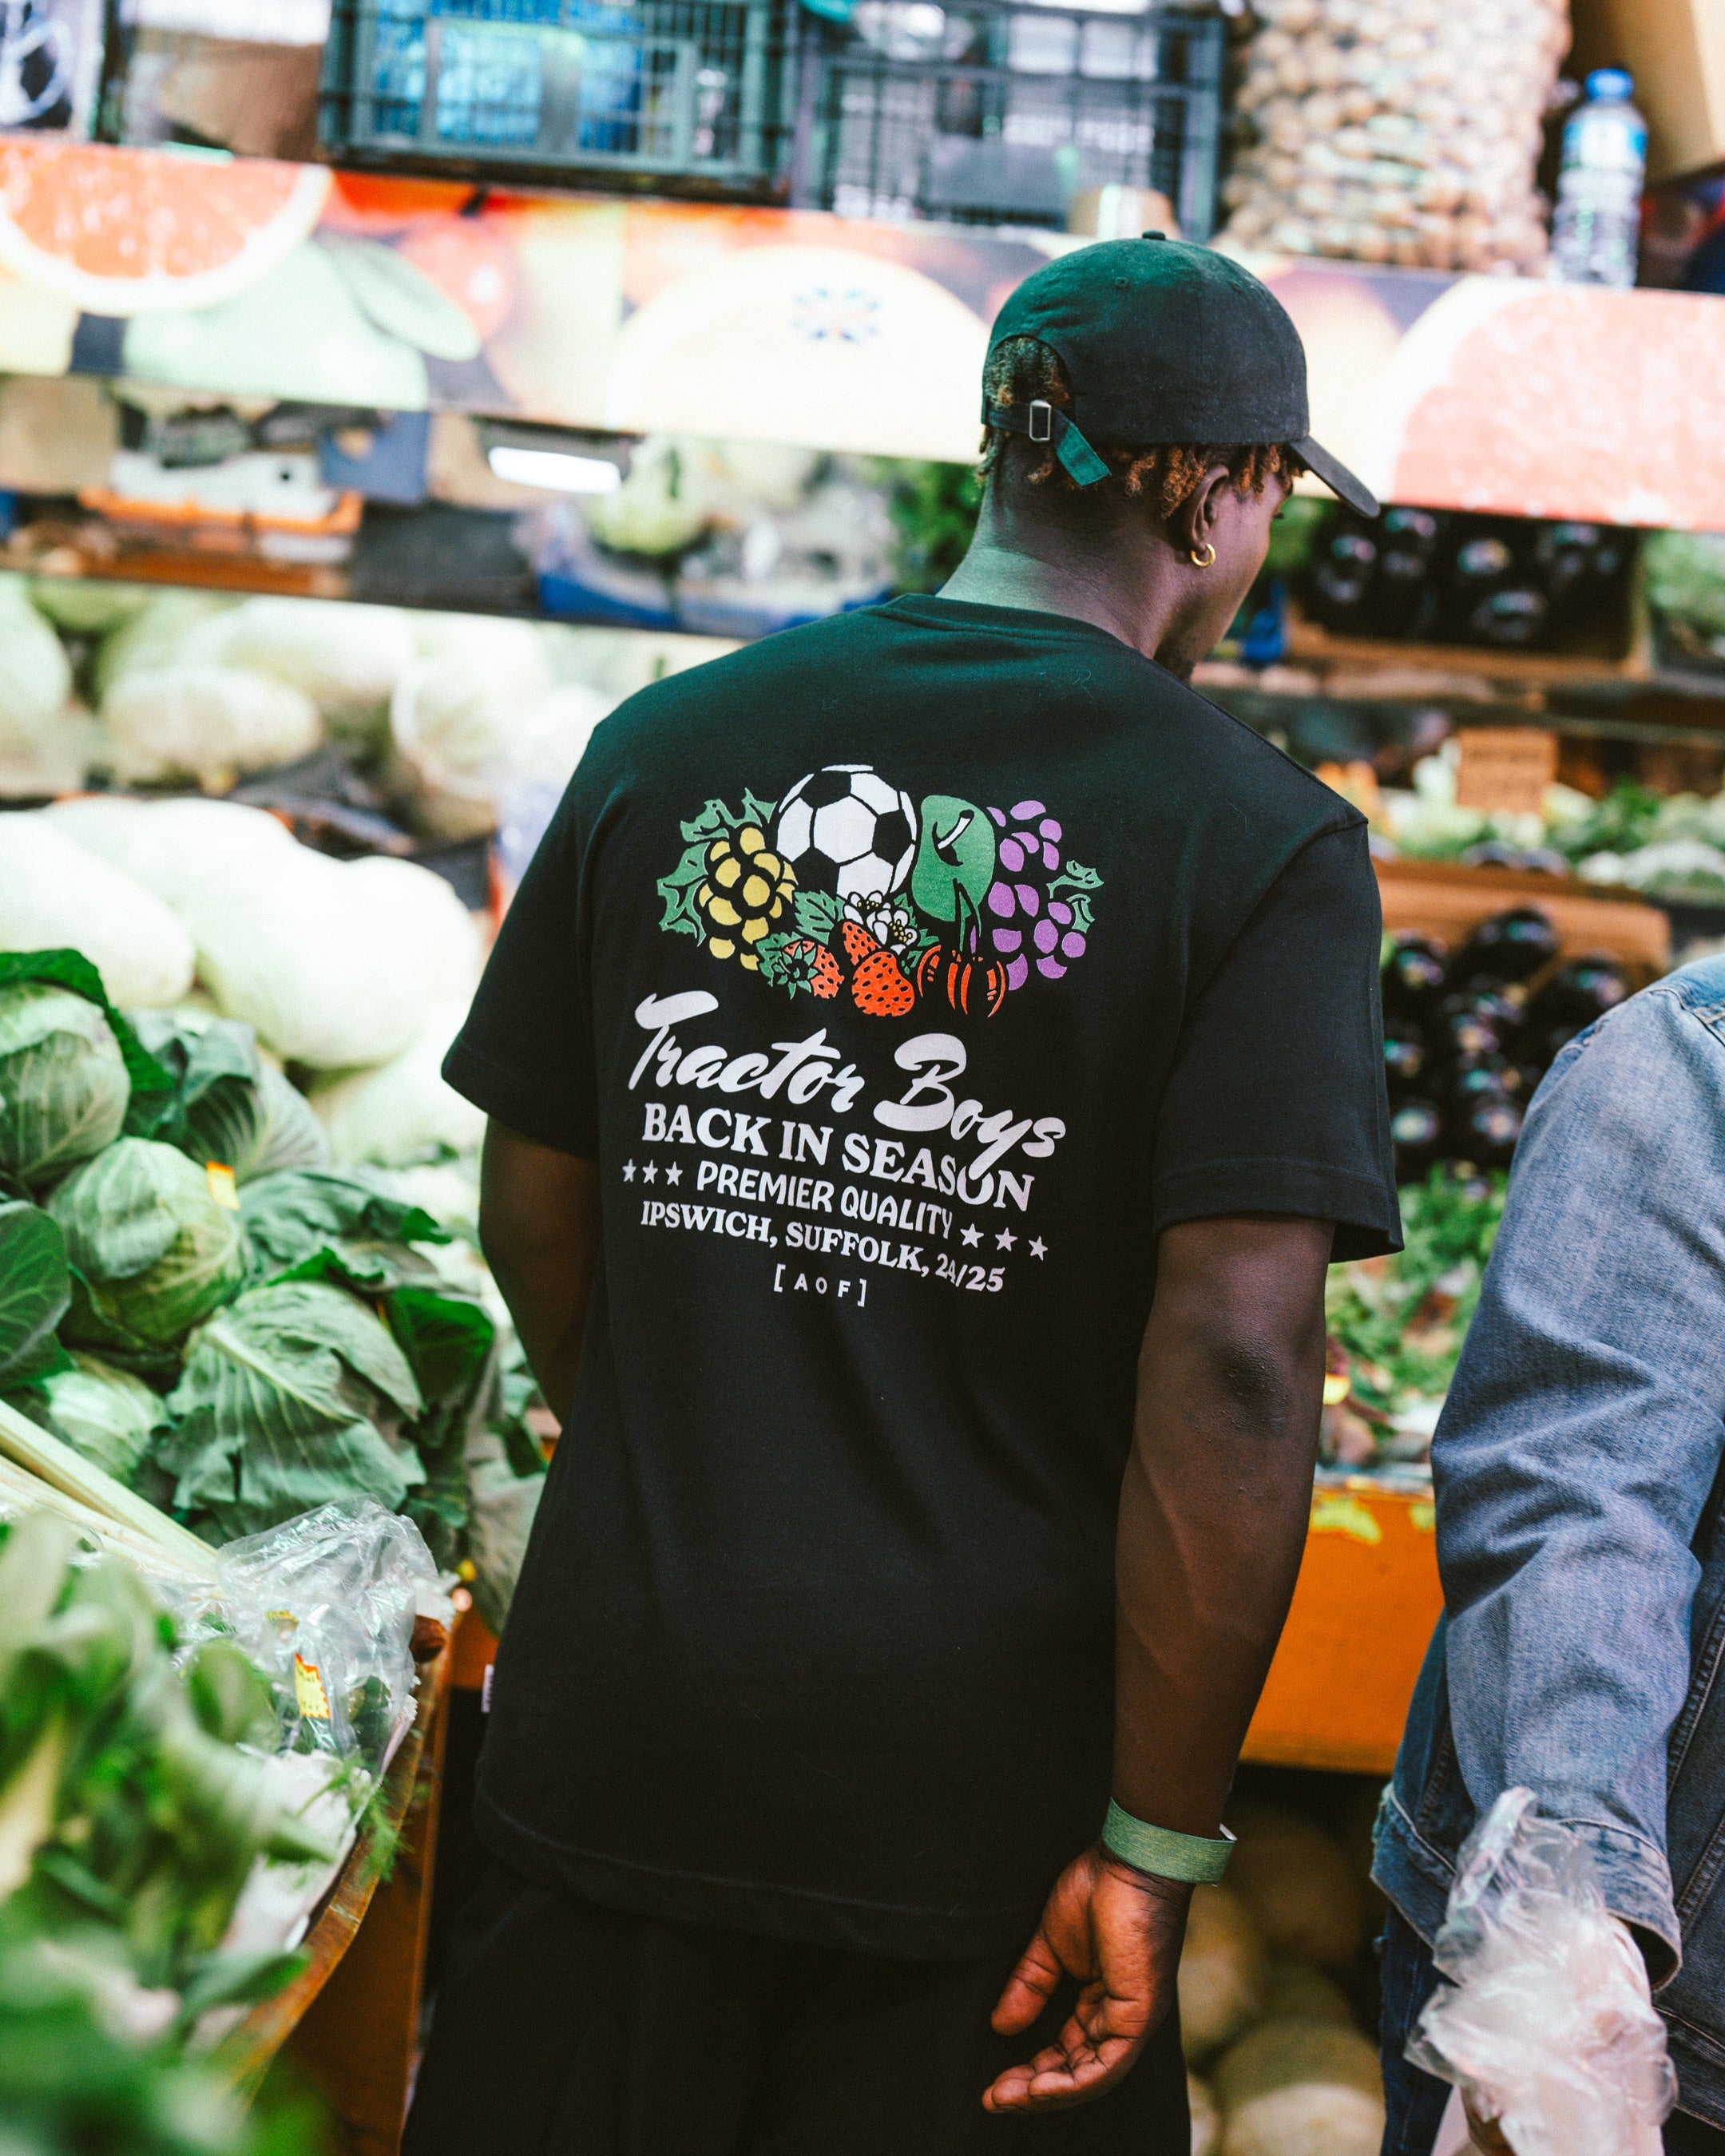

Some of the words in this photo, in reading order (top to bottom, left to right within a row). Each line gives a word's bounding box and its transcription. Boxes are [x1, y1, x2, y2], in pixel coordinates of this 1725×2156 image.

[629, 991, 865, 1112] Tractor
[873, 1033, 1066, 1181] Boys
[641, 1102, 772, 1157] BACK
[778, 1120, 835, 1166] IN
[841, 1132, 1035, 1212] SEASON
[696, 1159, 835, 1213] PREMIER
[840, 1185, 953, 1240] QUALITY
[640, 1200, 778, 1249] IPSWICH,
[785, 1221, 930, 1278] SUFFOLK,
[934, 1253, 1005, 1292] 24/25
